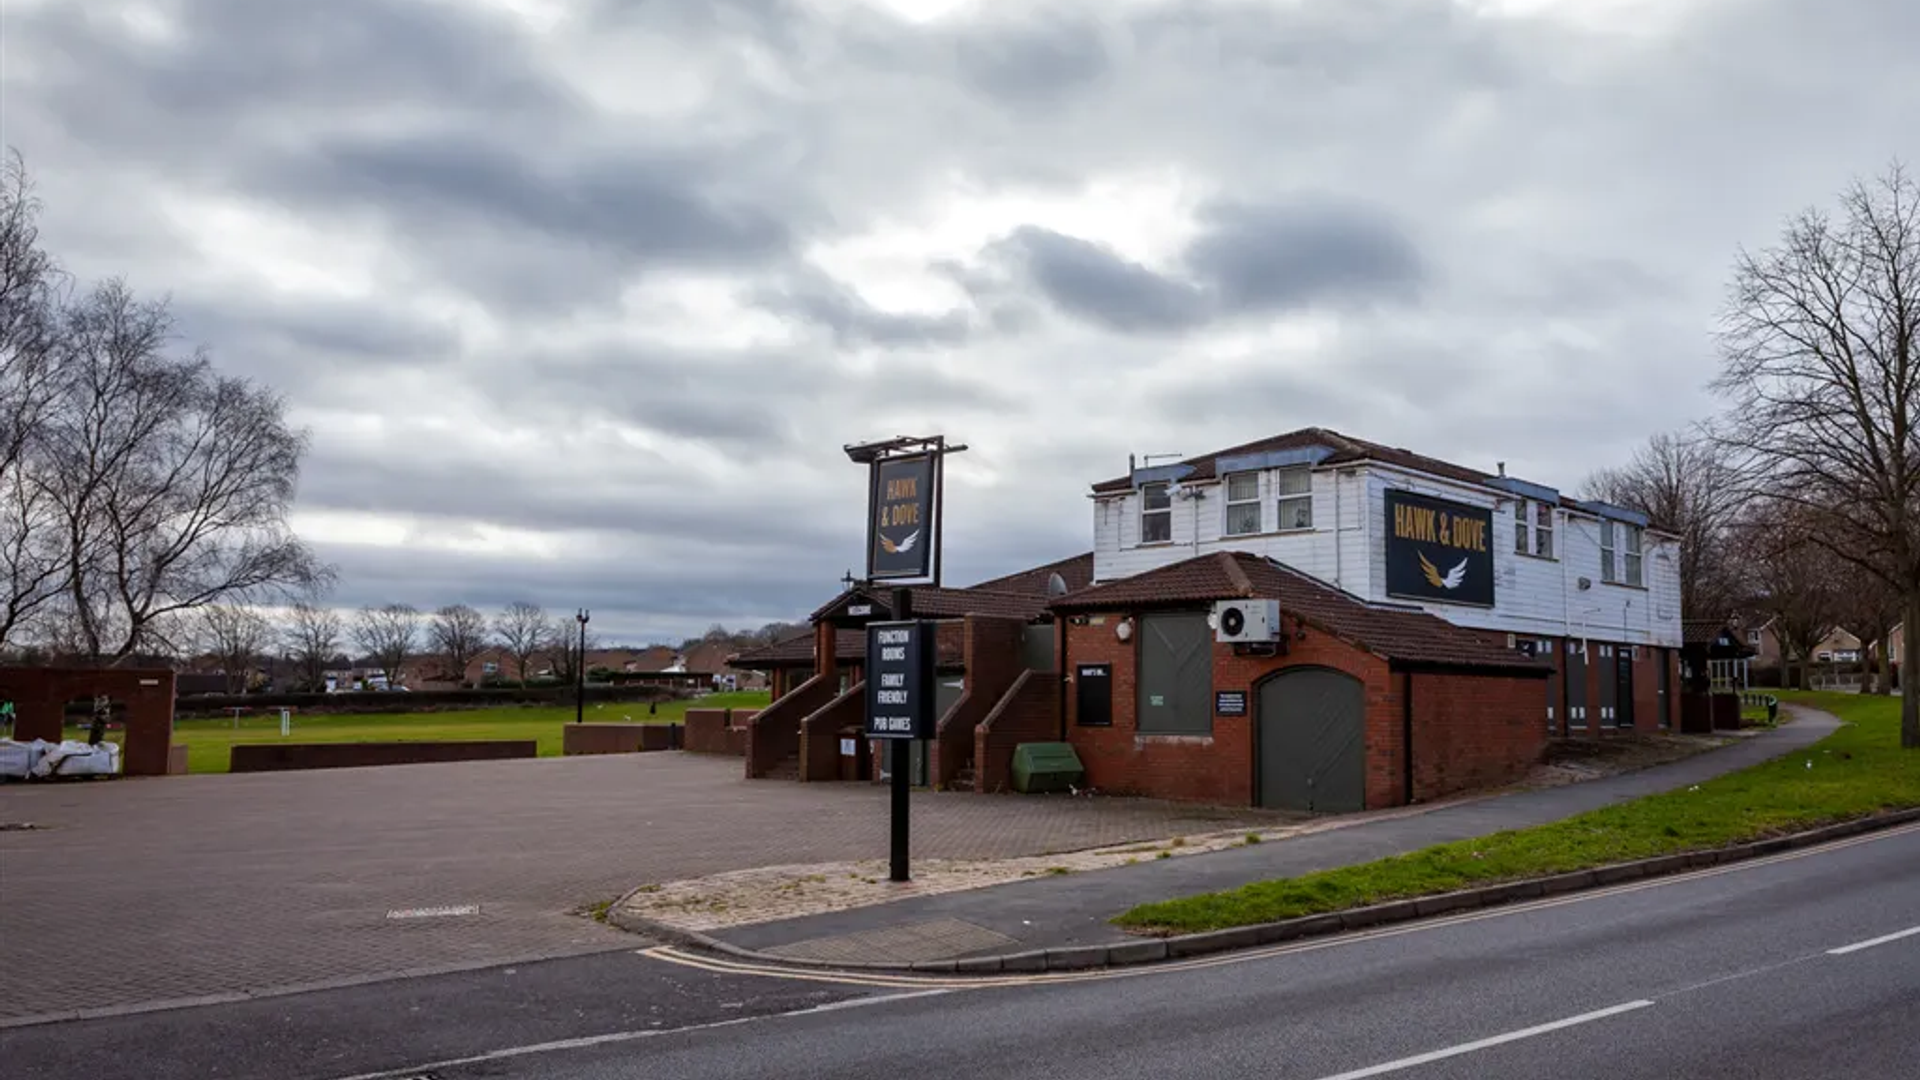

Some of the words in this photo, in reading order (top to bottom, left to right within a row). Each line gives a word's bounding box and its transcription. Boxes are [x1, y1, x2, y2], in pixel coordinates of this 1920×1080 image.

[887, 478, 917, 500] HAWK
[881, 506, 889, 527] &
[892, 502, 920, 526] DOVE
[1394, 503, 1437, 543] HAWK
[1439, 511, 1451, 546] &
[1452, 515, 1486, 552] DOVE
[877, 630, 909, 644] FUNCTION
[881, 646, 905, 661] ROOMS
[881, 673, 905, 687] FAMILY
[877, 690, 909, 704] FRIENDLY
[874, 716, 888, 731] PUB
[889, 716, 911, 731] GAMES
